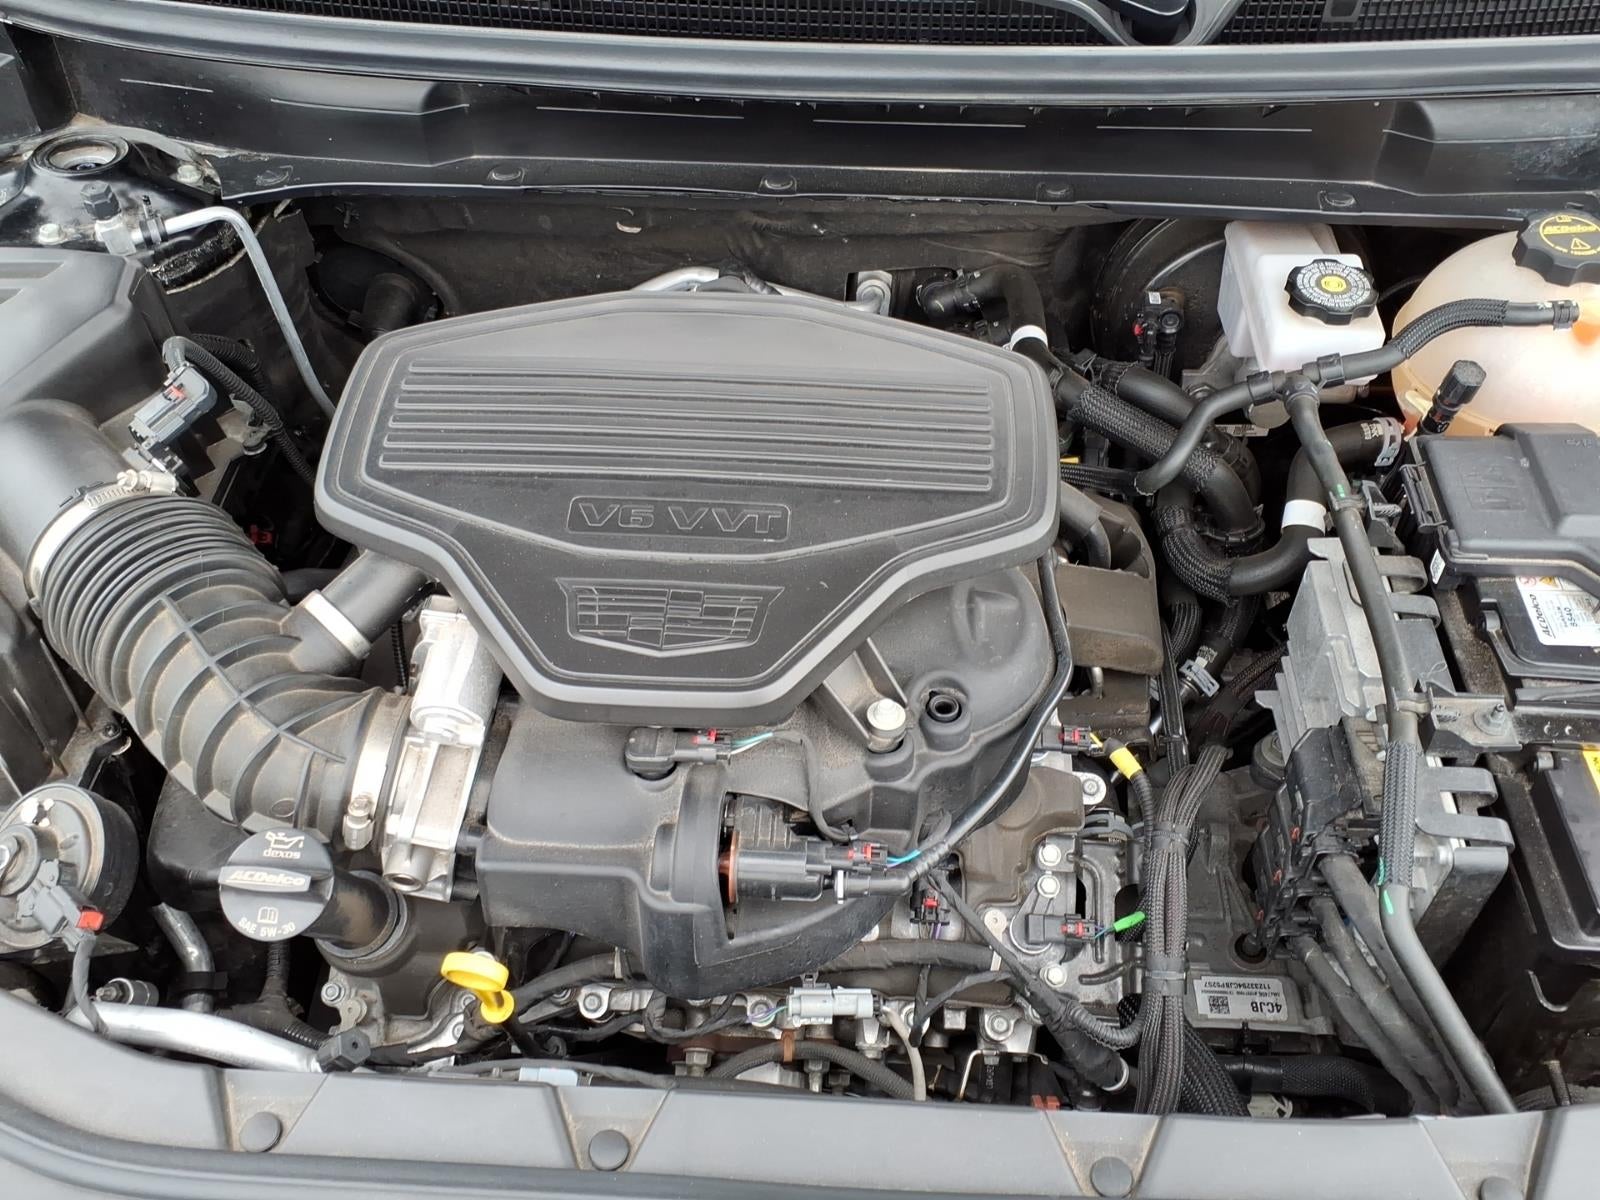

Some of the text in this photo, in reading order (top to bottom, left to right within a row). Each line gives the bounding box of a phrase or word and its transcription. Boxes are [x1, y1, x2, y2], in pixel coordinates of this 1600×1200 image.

[578, 502, 782, 534] V6 VVT
[1529, 593, 1553, 638] ACDelco
[262, 847, 301, 859] dexos
[228, 869, 306, 886] ACDelco
[238, 916, 257, 934] SAE
[1250, 1001, 1282, 1013] 4CJB
